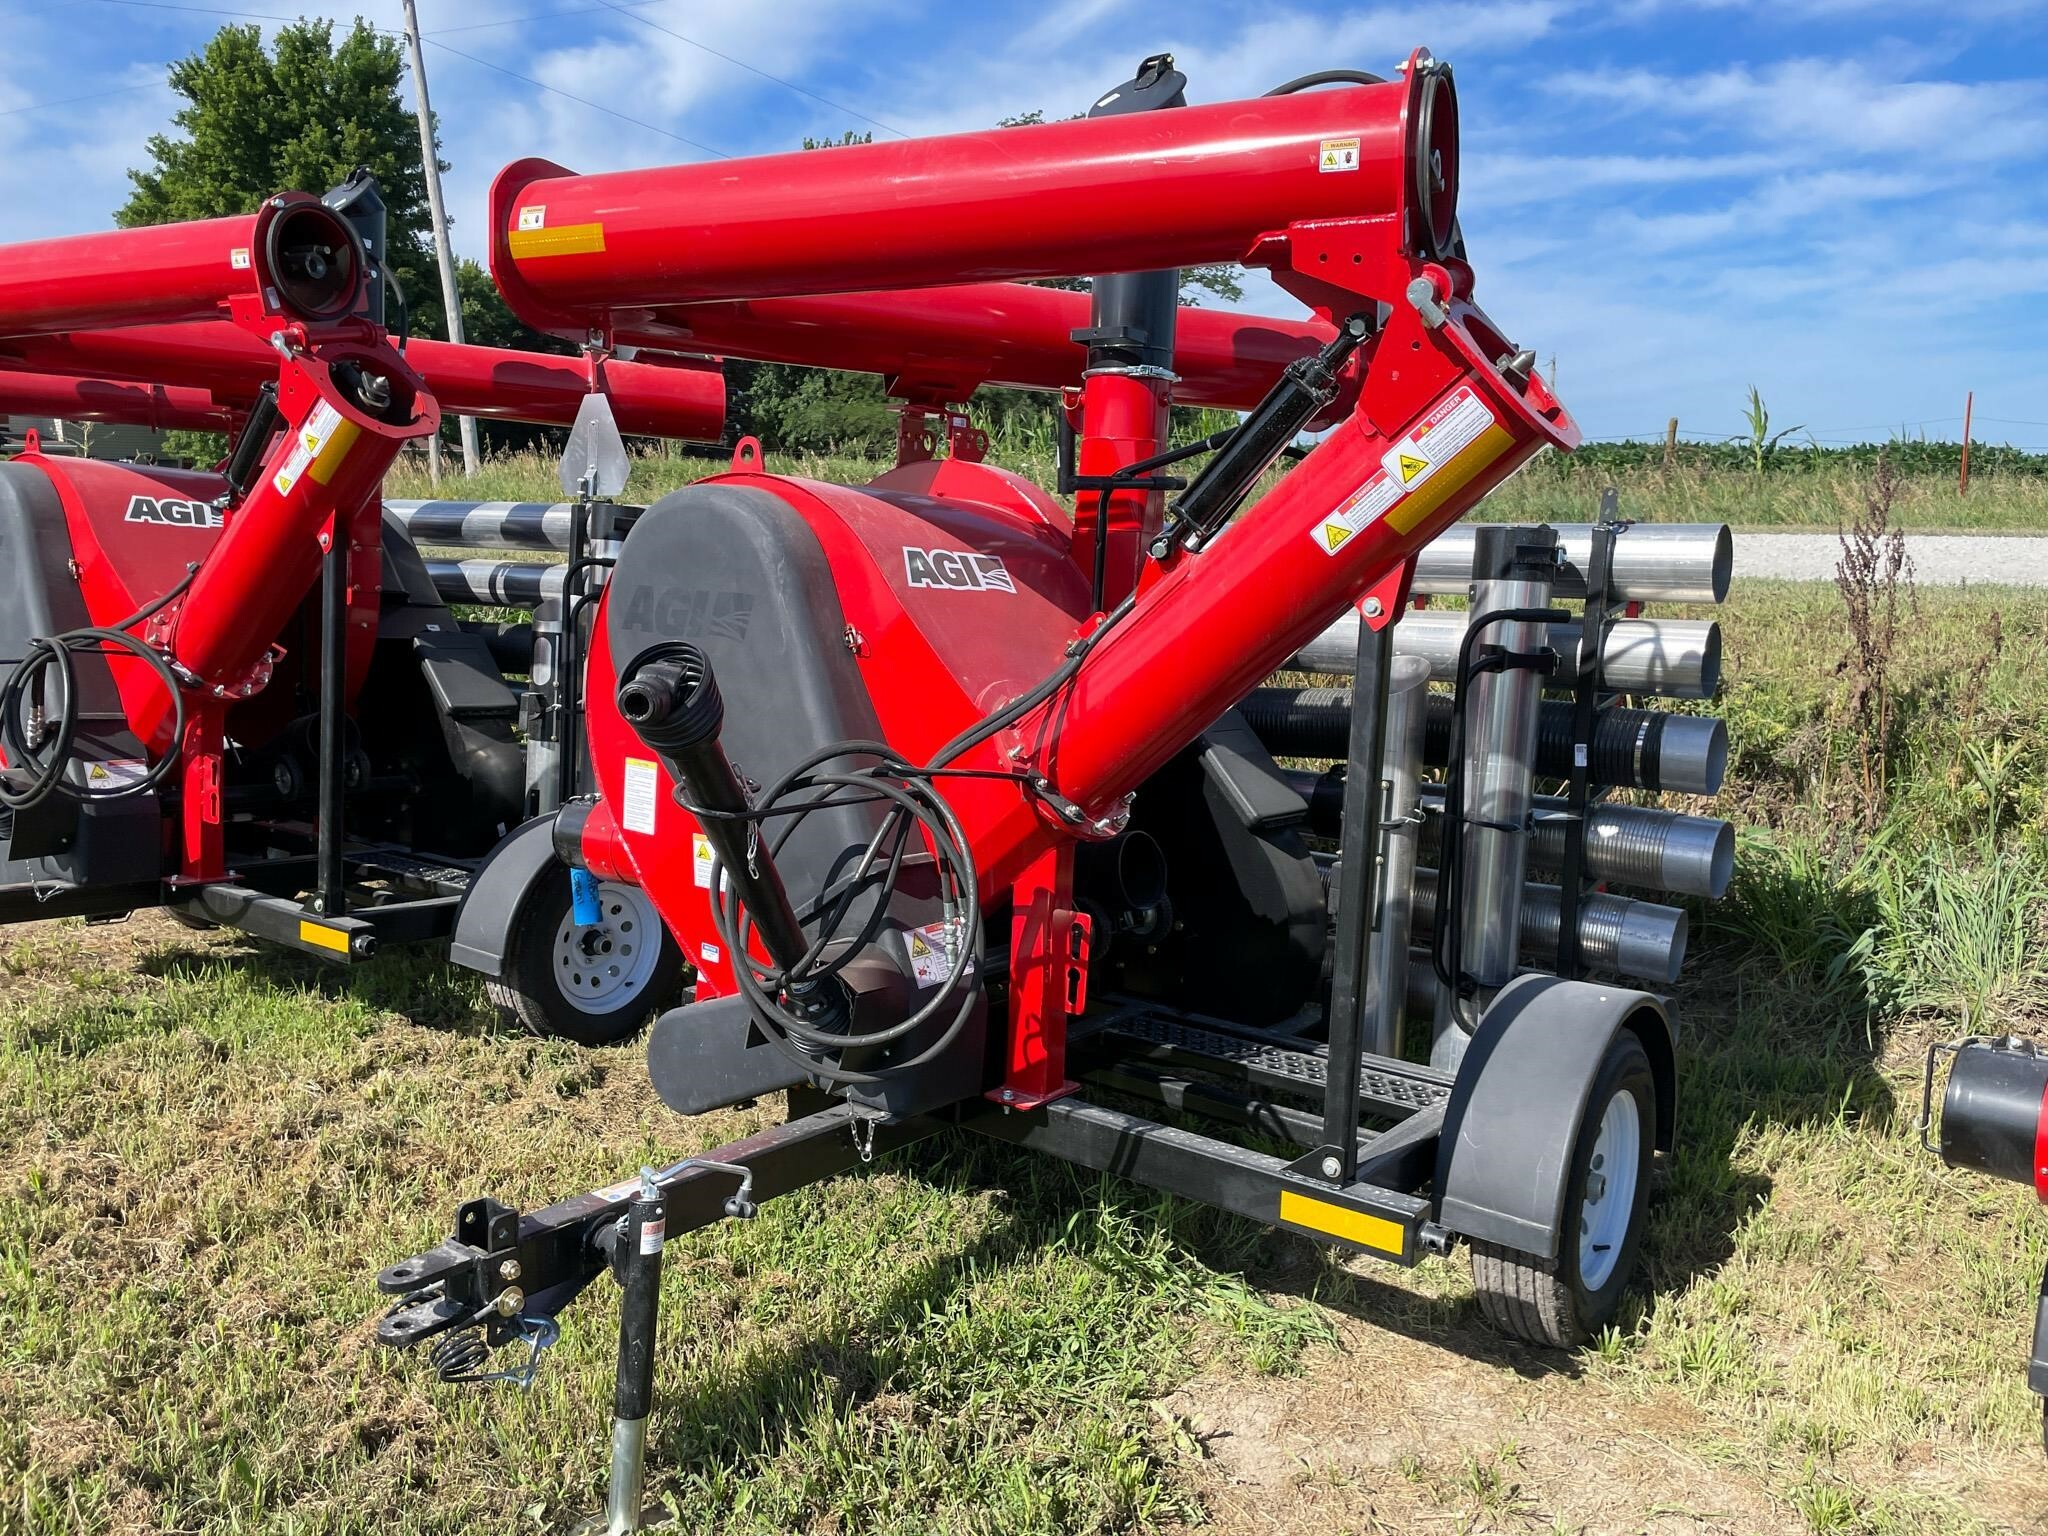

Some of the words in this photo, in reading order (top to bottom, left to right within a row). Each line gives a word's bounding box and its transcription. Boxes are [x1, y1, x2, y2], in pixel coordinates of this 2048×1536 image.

[1430, 396, 1462, 425] DANGER
[1355, 481, 1376, 500] DANGER
[129, 497, 207, 526] AGI
[906, 550, 982, 587] AGI
[622, 585, 709, 637] AGI
